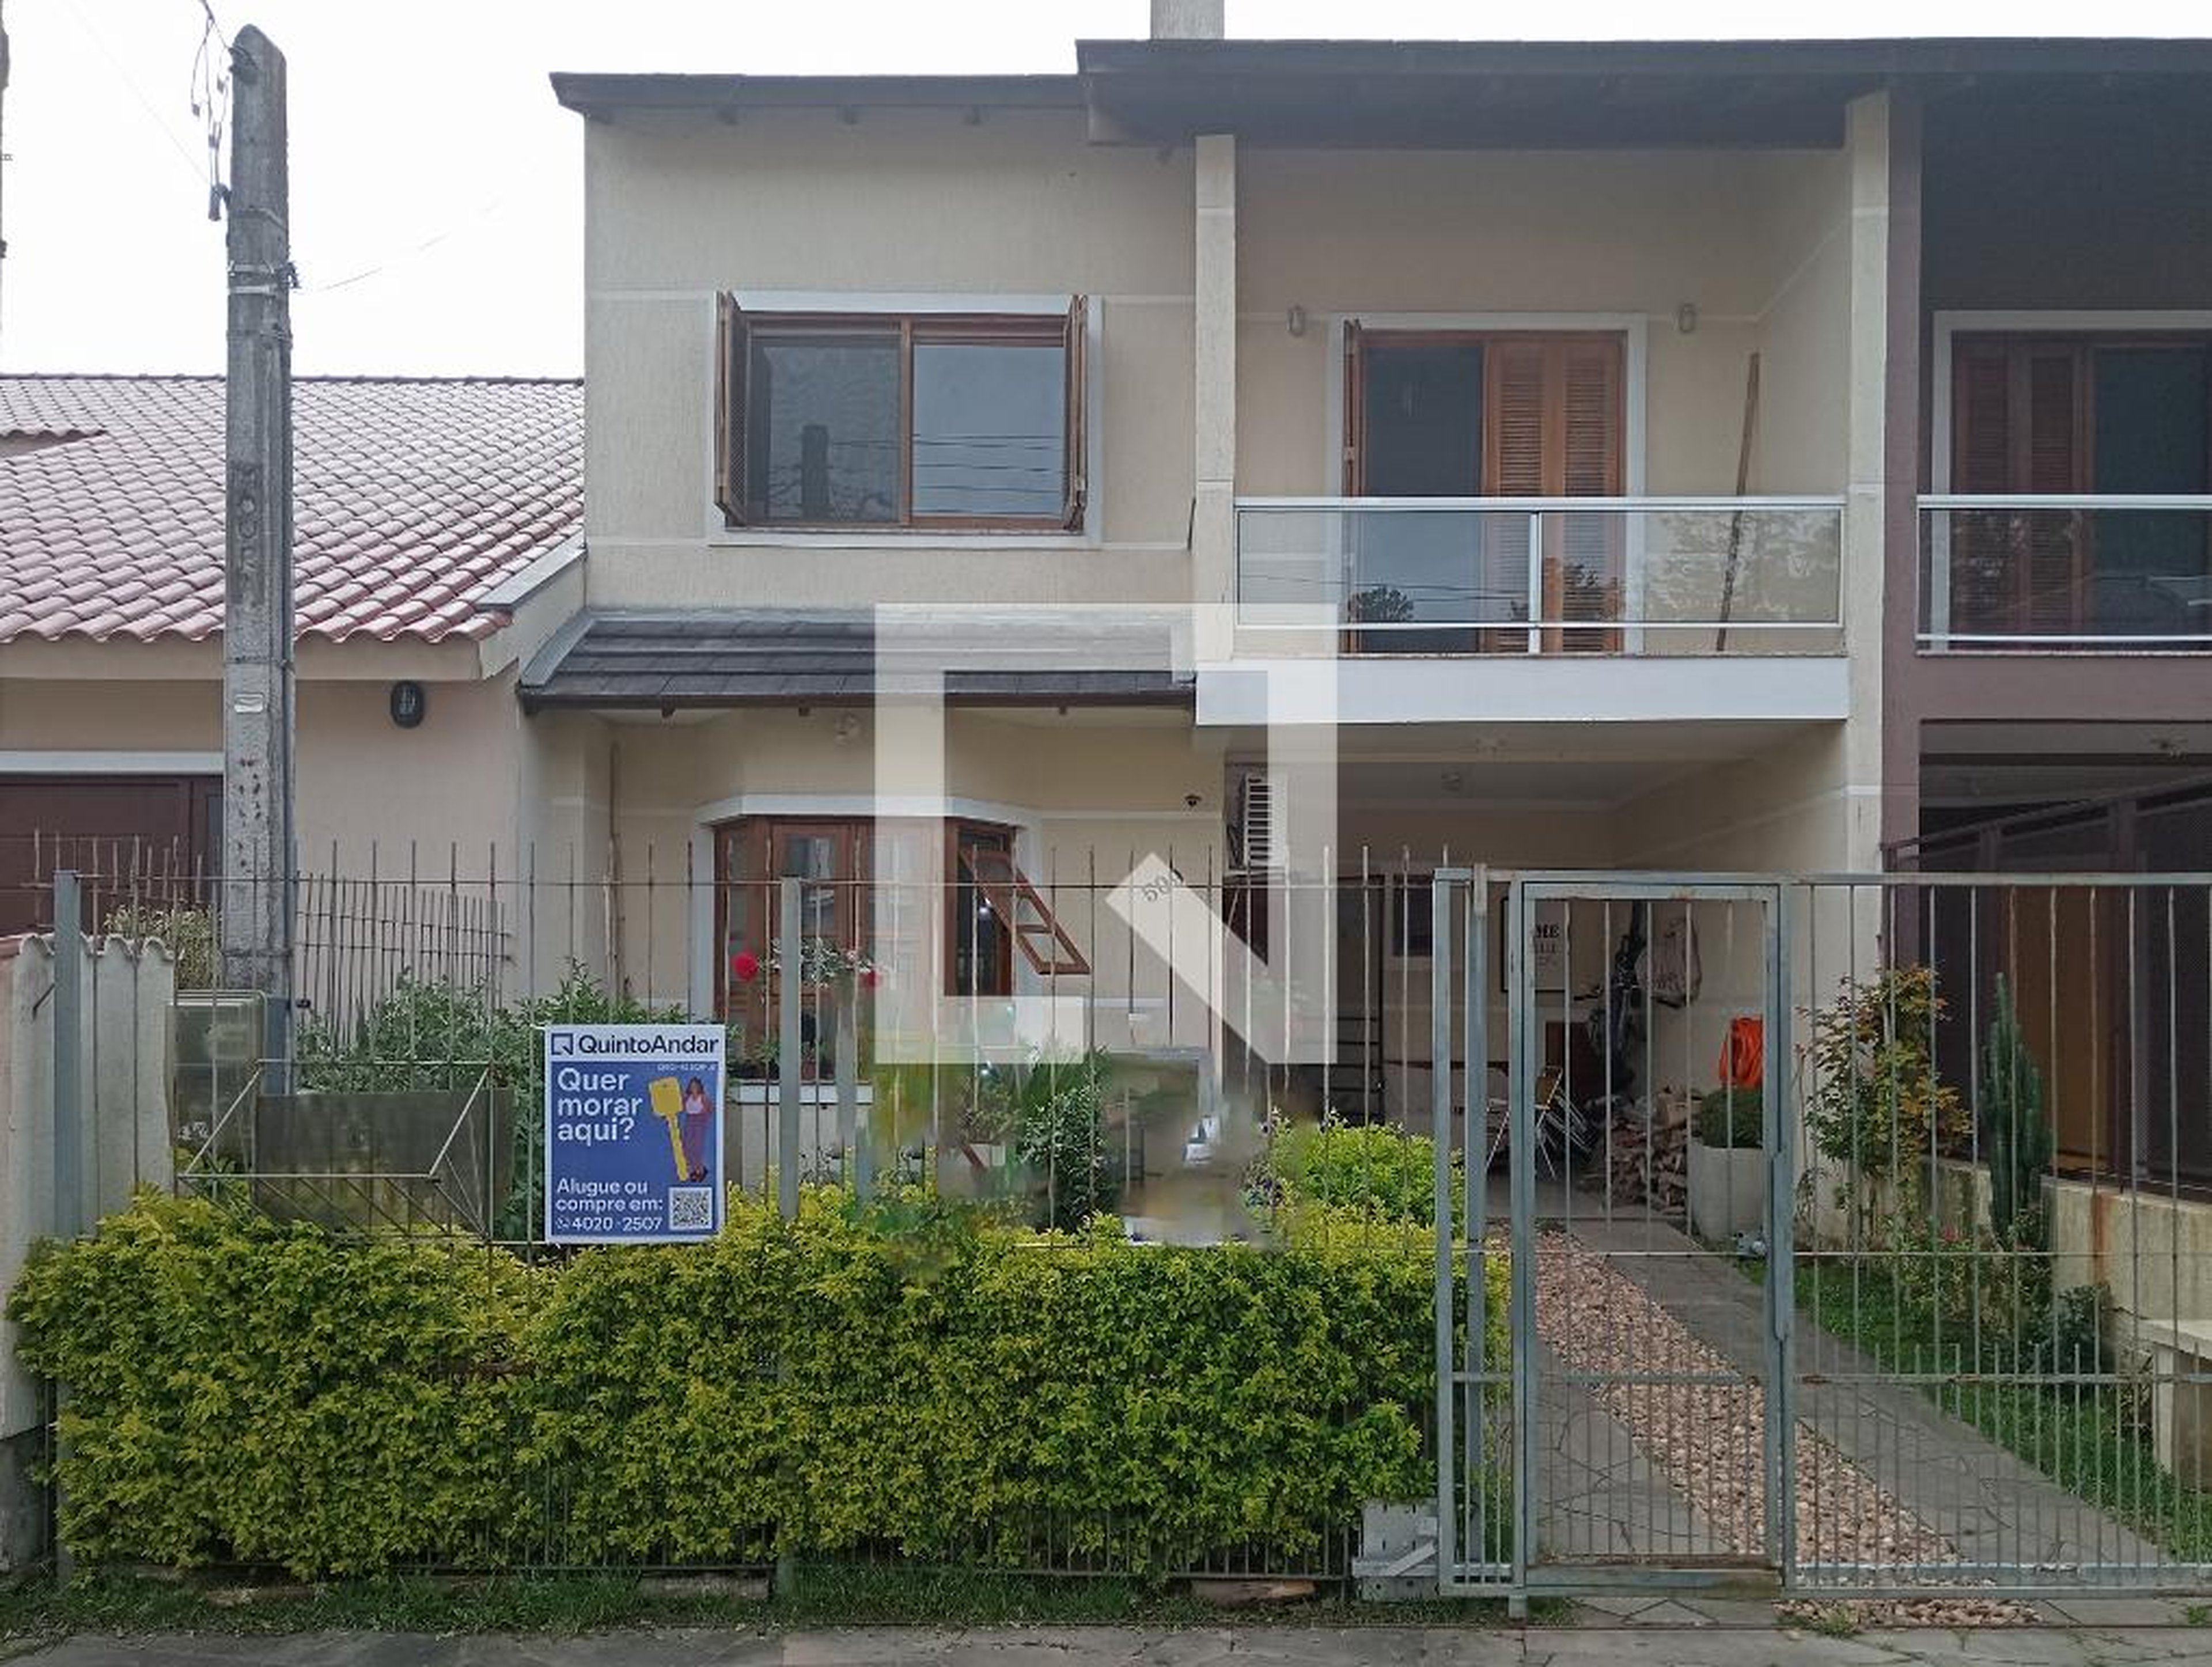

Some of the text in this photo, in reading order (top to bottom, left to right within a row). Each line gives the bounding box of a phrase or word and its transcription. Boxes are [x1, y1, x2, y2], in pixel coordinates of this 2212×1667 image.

[578, 1035, 719, 1054] QuintoAndar
[557, 1067, 630, 1092] Quer
[557, 1097, 643, 1116] morar
[557, 1117, 635, 1147] aqui?
[556, 1177, 648, 1197] Alugue ou
[555, 1199, 664, 1214] compre em:
